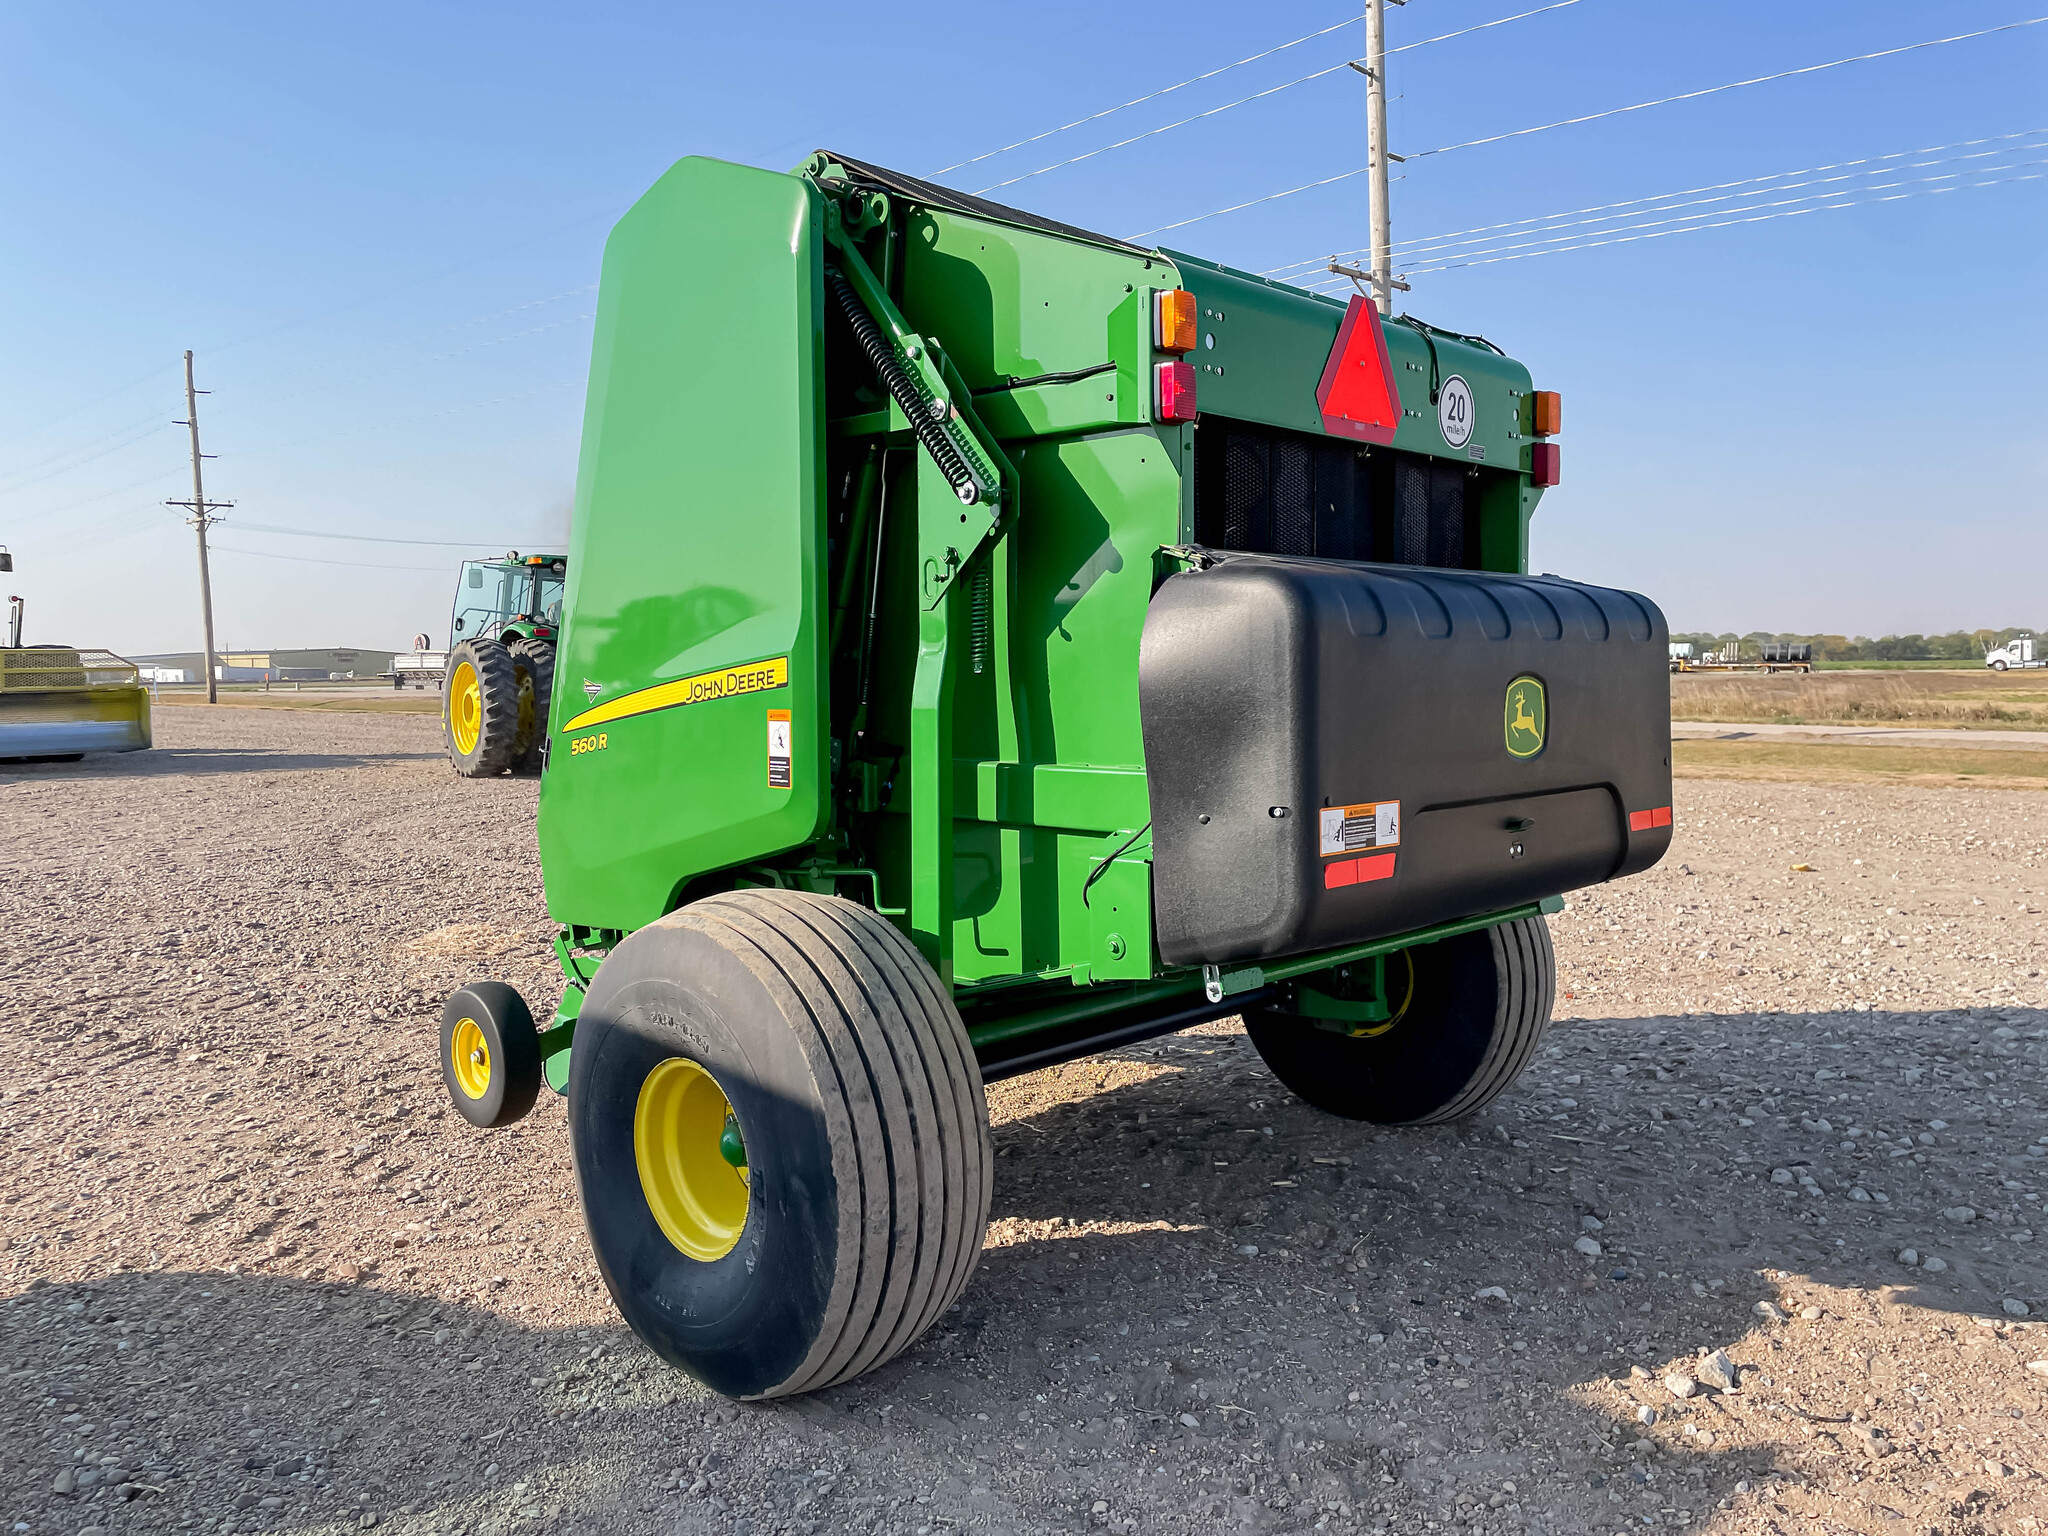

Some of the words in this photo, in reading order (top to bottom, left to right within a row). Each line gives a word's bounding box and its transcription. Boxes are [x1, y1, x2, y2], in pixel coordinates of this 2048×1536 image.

[1447, 392, 1465, 423] 20
[685, 677, 723, 702] JOHN
[726, 668, 775, 693] DEERE
